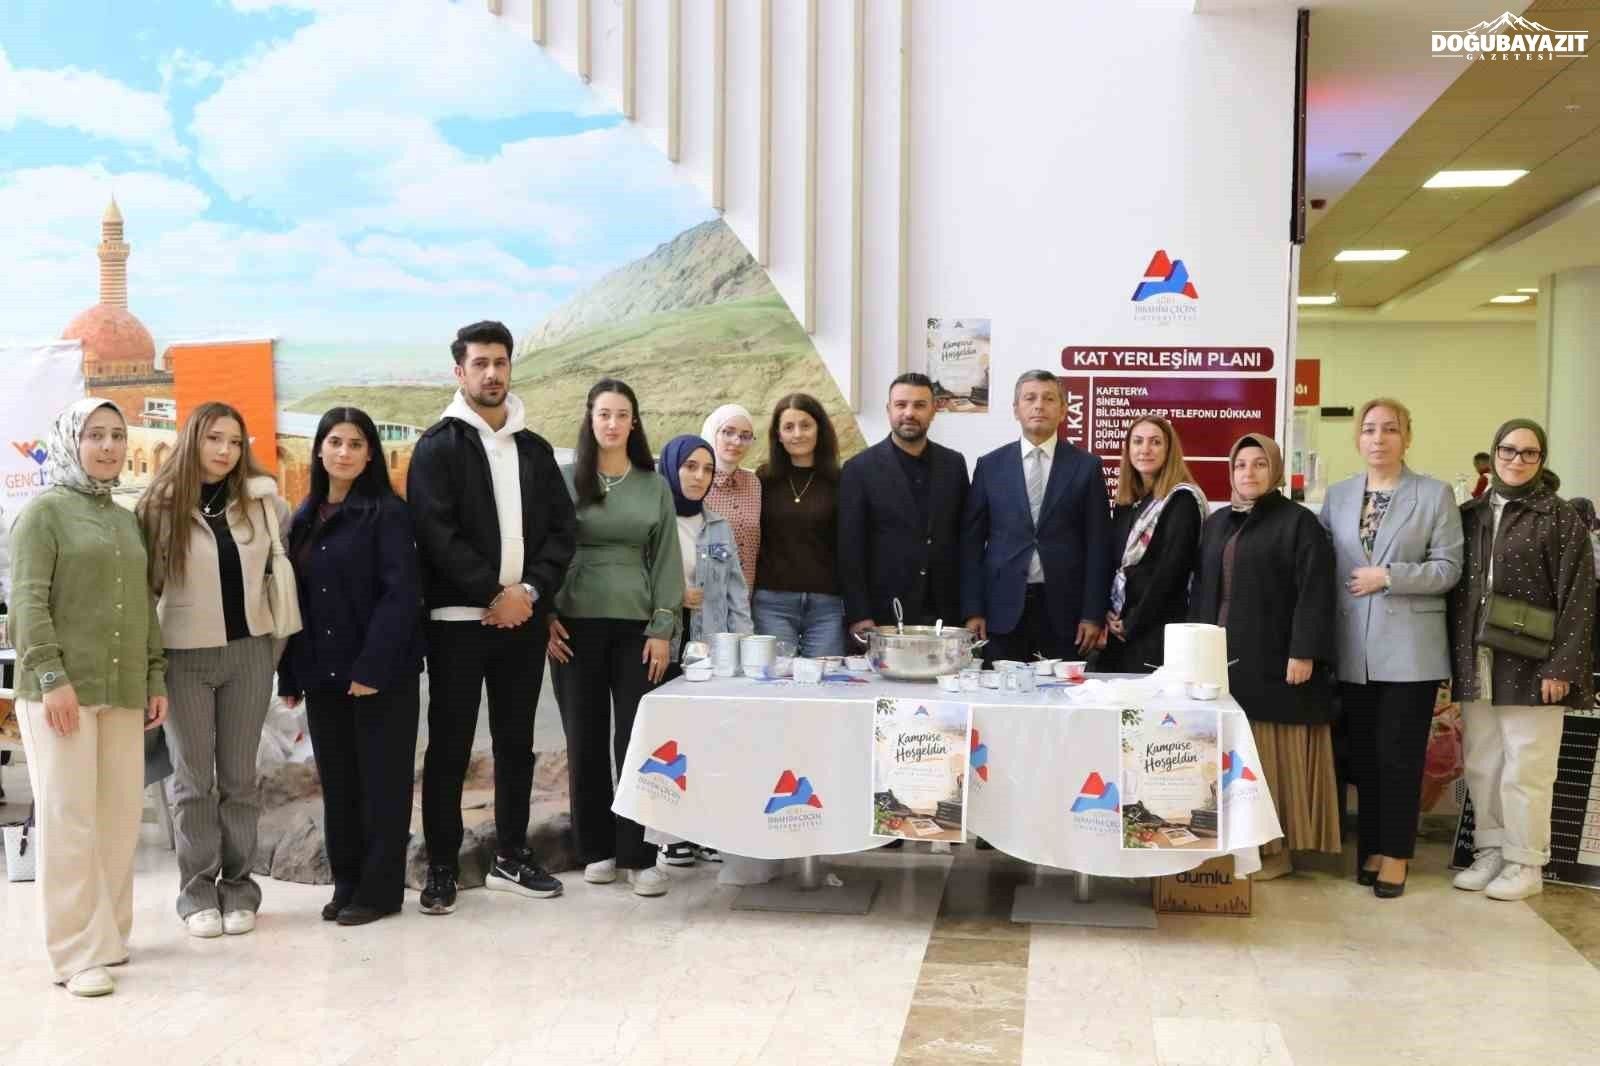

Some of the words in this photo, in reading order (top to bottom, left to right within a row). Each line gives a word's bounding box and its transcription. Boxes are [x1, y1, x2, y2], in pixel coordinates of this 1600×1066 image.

[1073, 352, 1108, 366] KAT
[1113, 350, 1202, 370] YERLEŞİM
[1208, 352, 1262, 367] PLANI
[1095, 387, 1149, 396] KAFETERYA
[1095, 398, 1130, 407] SİNEMA
[1067, 391, 1084, 445] 1.KAT
[1170, 409, 1217, 419] TELEFONU
[1219, 408, 1262, 419] DÜKKANI
[1095, 420, 1120, 428] UNLU
[1095, 440, 1120, 450] GİYİM
